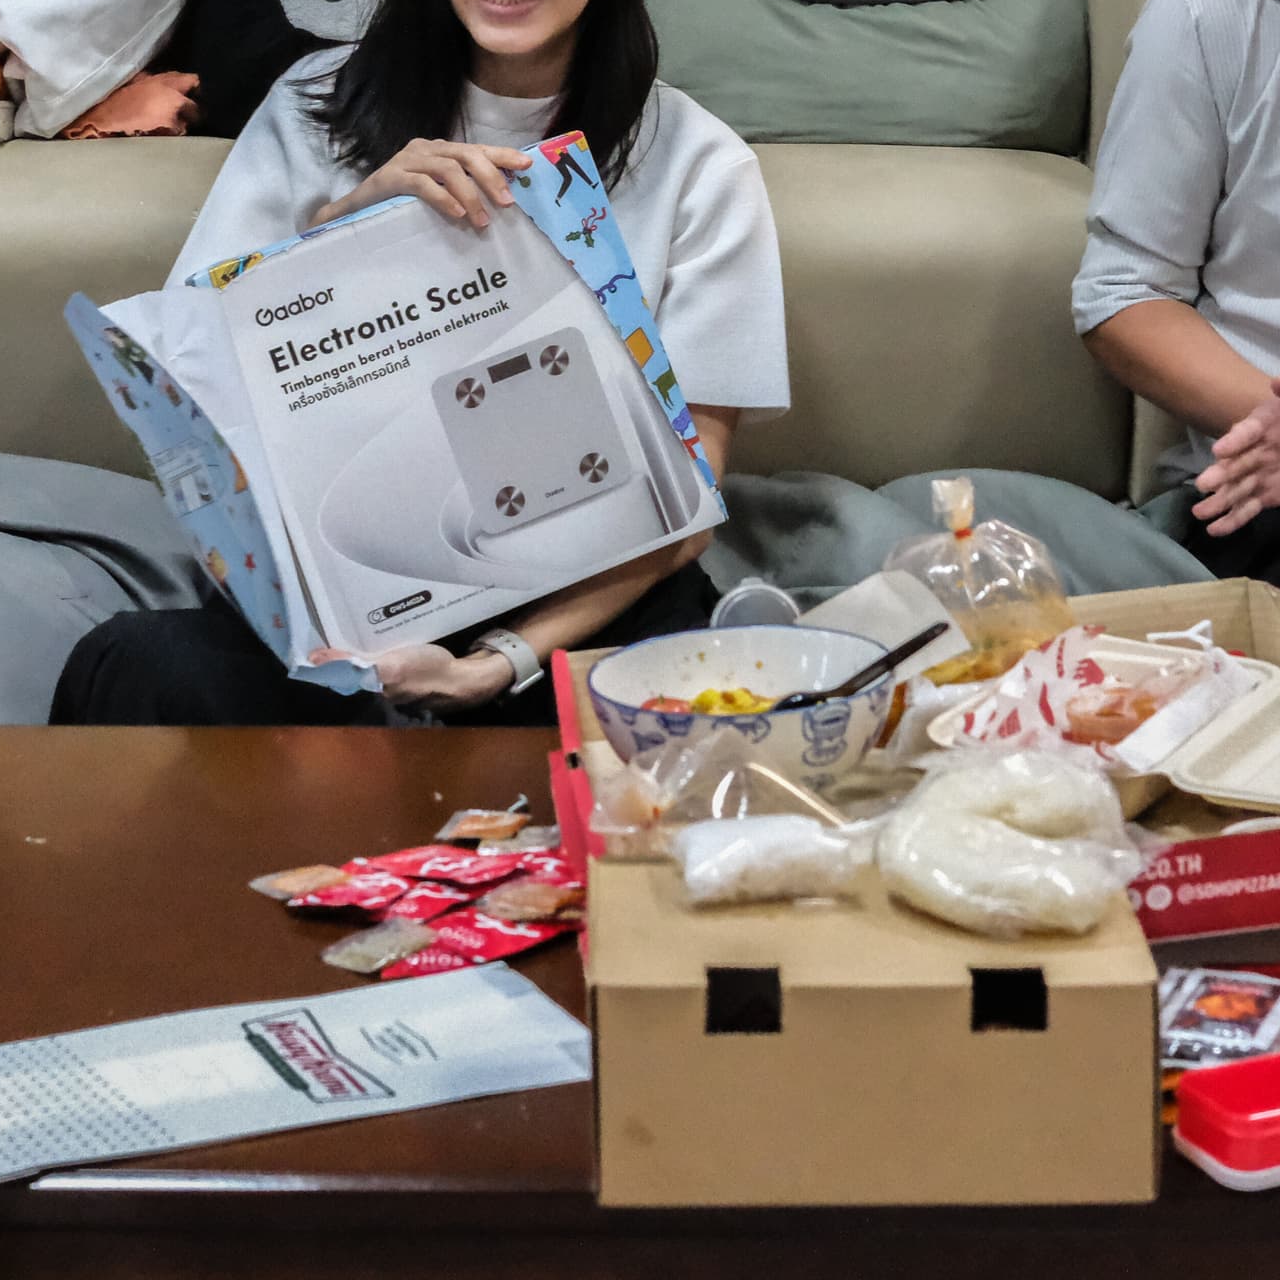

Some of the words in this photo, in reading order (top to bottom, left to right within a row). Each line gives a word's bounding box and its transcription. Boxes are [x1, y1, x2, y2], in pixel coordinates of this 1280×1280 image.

[255, 286, 335, 327] Gaabor
[268, 301, 420, 373] Electronic
[426, 267, 509, 312] Scale
[280, 359, 356, 395] Timbangan
[358, 344, 396, 368] berat
[397, 327, 442, 352] badan
[444, 300, 510, 333] elektronik
[288, 356, 412, 412] เครื่องชั่งอิเล็กทรอนิกส์
